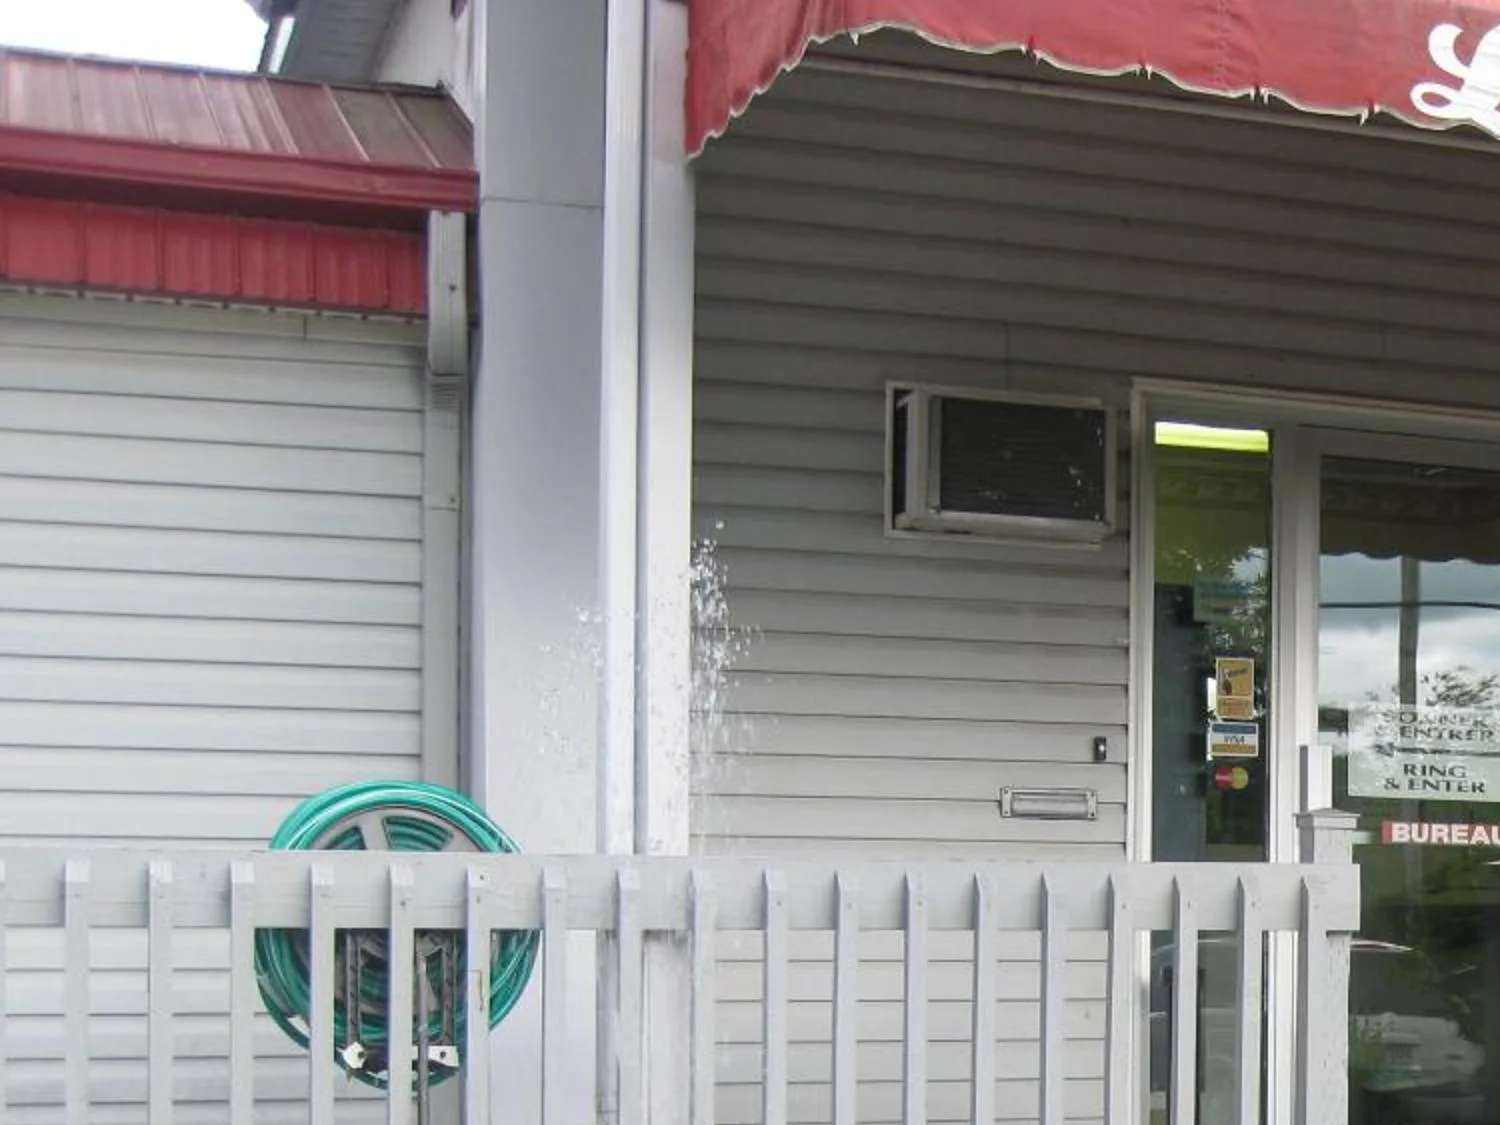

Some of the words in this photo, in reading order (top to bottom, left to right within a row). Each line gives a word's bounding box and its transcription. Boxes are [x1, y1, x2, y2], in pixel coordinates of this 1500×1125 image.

[1399, 725, 1495, 741] ENTRER
[1403, 763, 1468, 779] RING
[1384, 777, 1400, 791] &
[1408, 778, 1486, 793] ENTER
